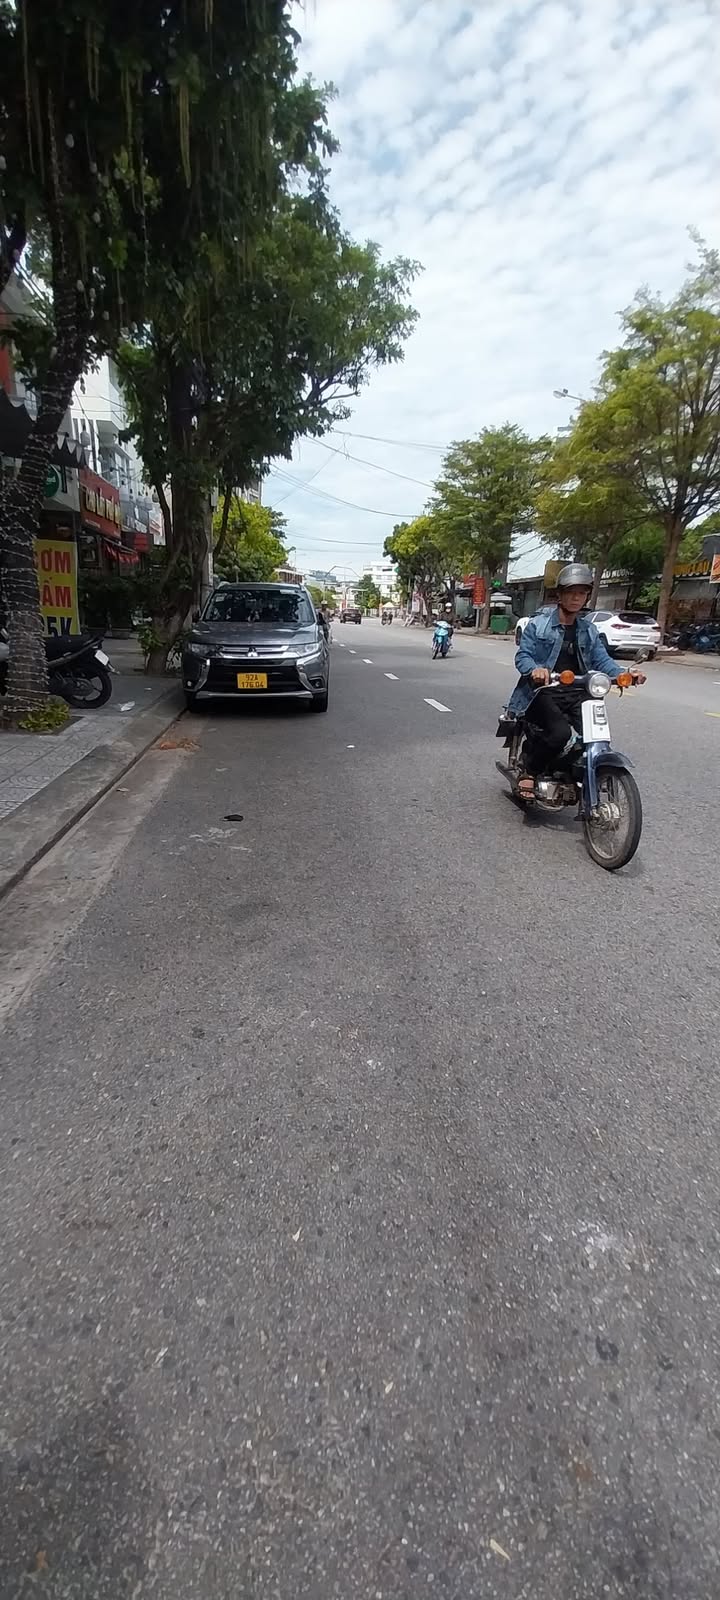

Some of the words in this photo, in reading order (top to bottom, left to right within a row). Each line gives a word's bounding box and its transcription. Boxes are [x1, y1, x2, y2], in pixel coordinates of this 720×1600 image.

[36, 547, 71, 573] ƠM
[41, 576, 72, 608] ẤM
[38, 615, 72, 637] 5K
[245, 673, 259, 681] 92A
